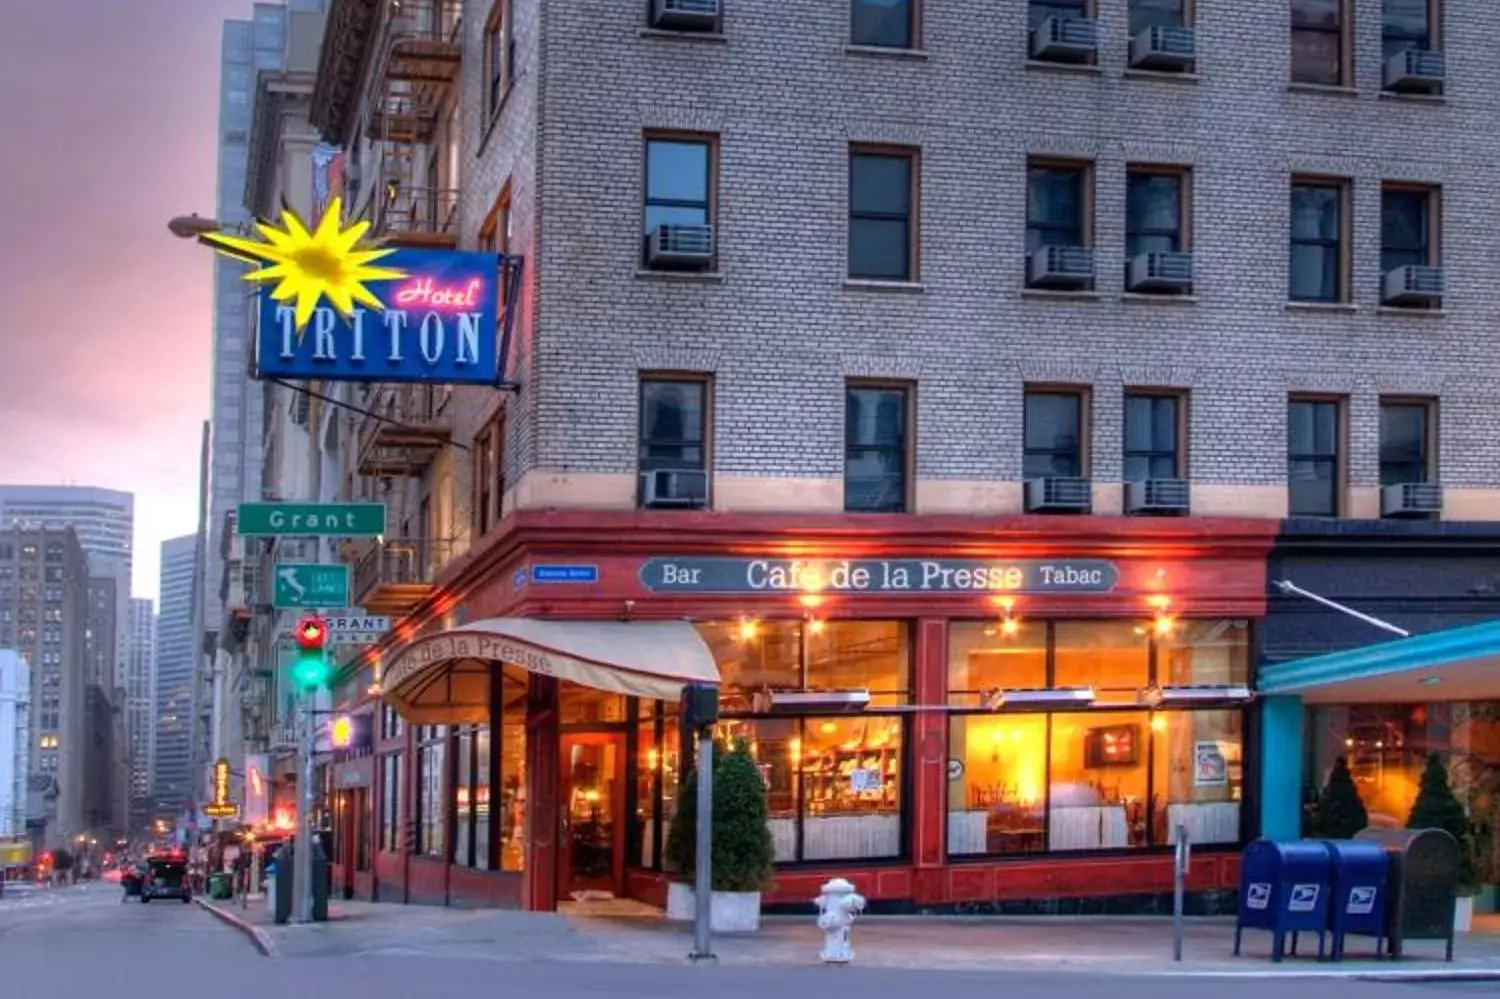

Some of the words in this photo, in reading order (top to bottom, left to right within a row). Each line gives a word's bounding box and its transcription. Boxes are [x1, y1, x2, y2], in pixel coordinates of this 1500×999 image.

[397, 278, 481, 307] Hotel
[275, 305, 483, 365] TRITON
[269, 511, 356, 528] Grant
[662, 564, 702, 584] Bar
[830, 561, 871, 589] de
[880, 561, 910, 589] la
[920, 561, 1023, 589] Presse
[1040, 565, 1102, 584] Tabac
[450, 635, 469, 656] la
